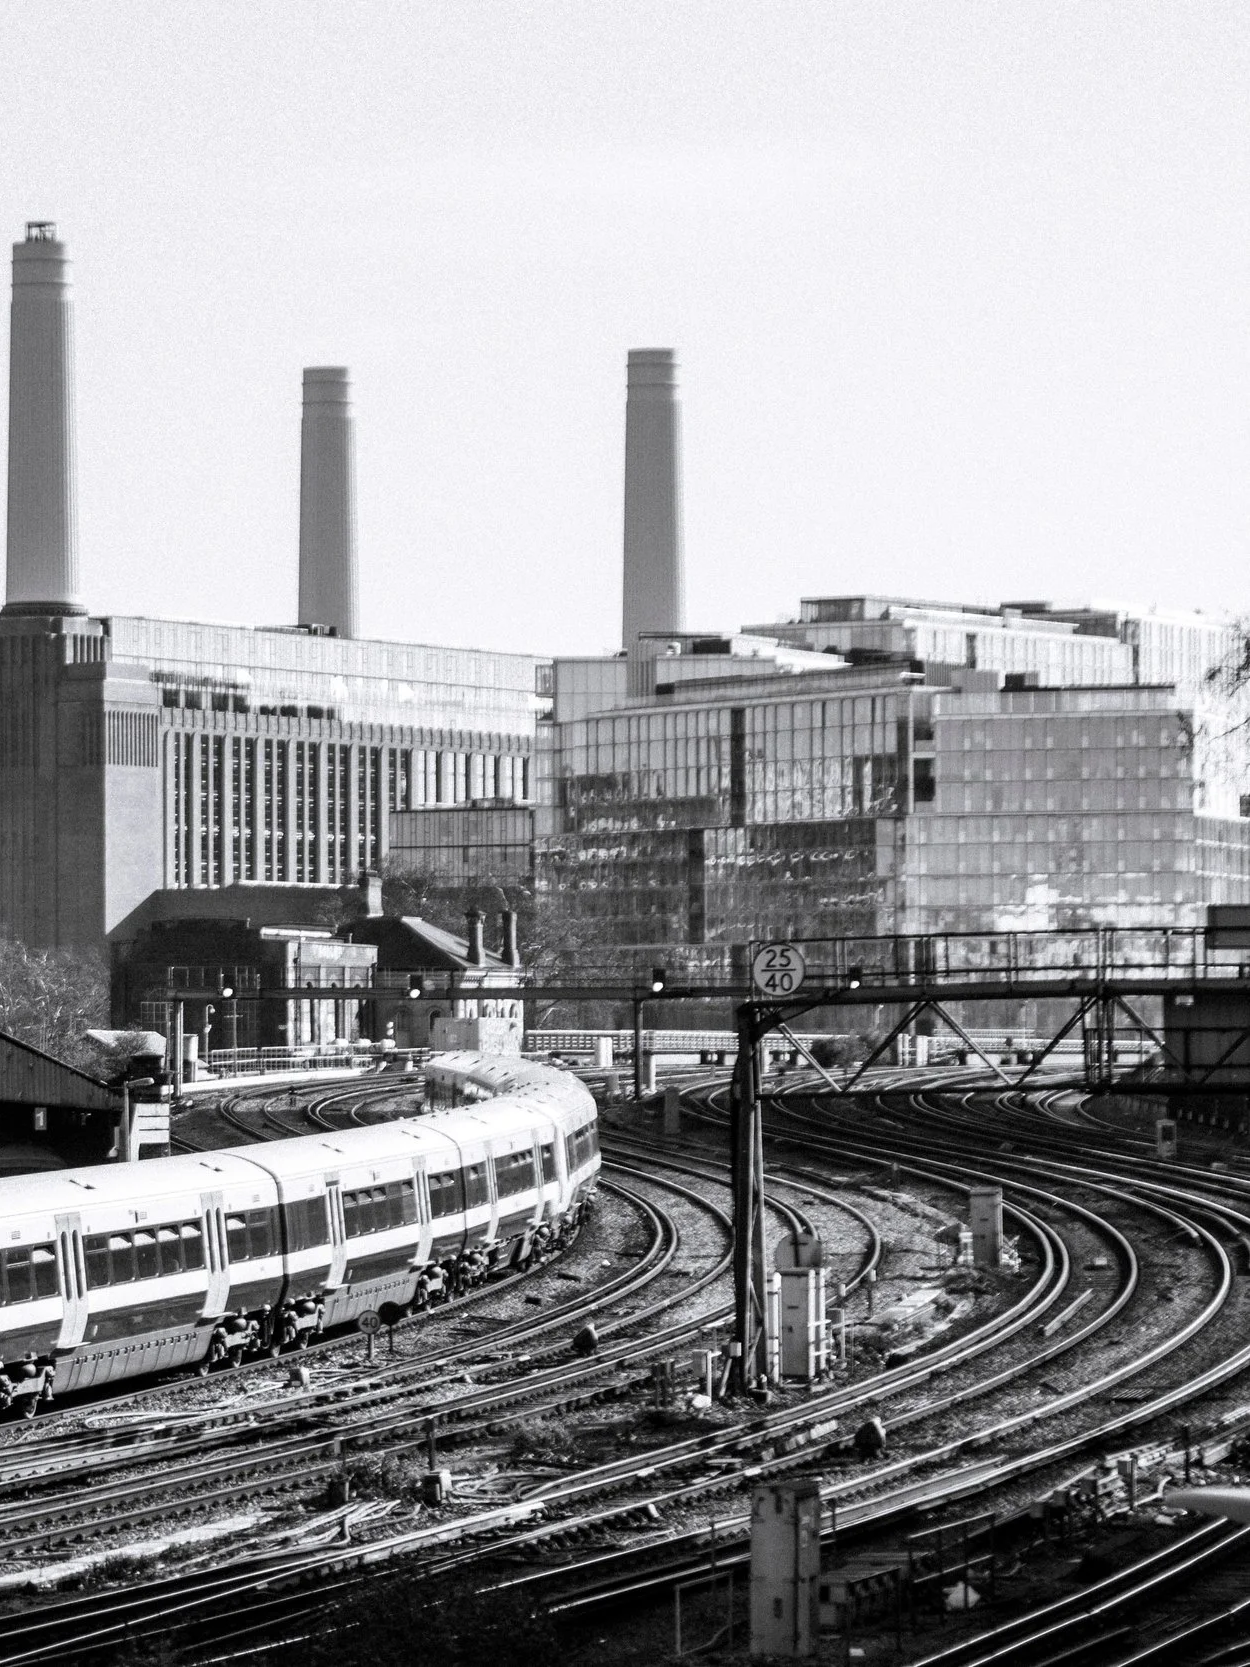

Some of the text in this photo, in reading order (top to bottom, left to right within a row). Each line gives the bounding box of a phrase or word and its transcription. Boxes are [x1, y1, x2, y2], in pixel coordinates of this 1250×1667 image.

[766, 949, 791, 967] 25
[765, 973, 793, 992] 40
[36, 1111, 44, 1127] 1
[361, 1316, 378, 1328] 40
